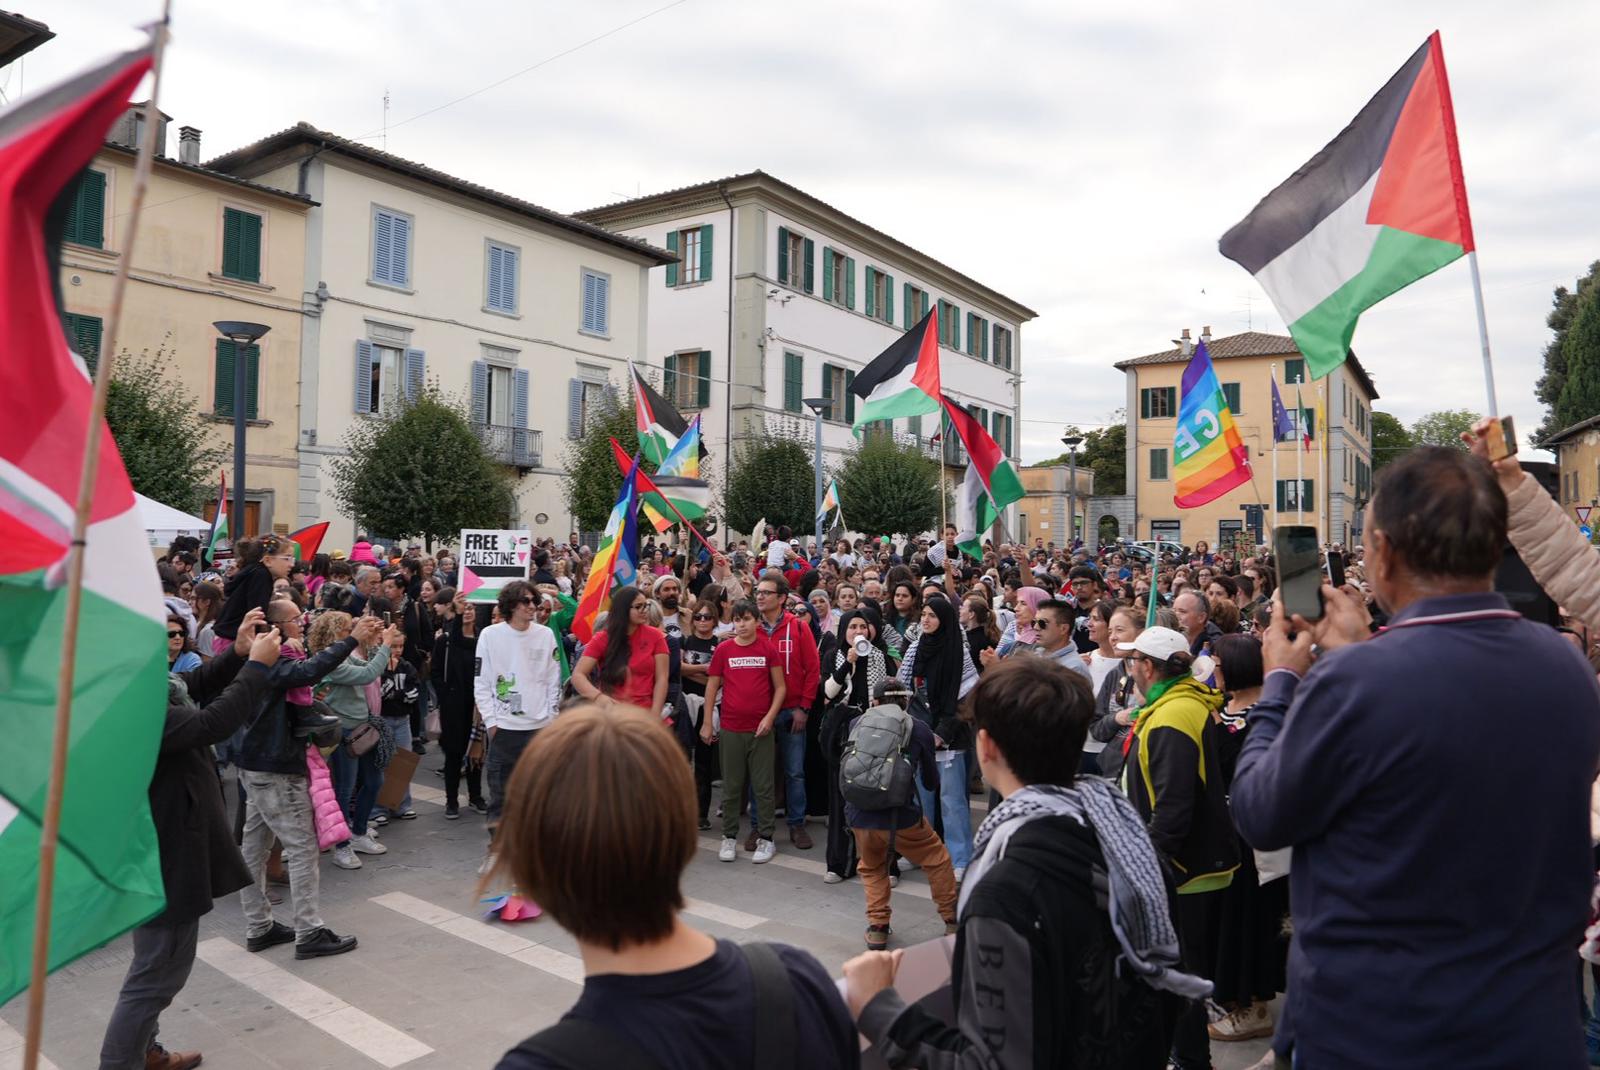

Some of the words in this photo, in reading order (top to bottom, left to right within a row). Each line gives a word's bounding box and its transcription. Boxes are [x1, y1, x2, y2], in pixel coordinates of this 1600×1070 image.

[465, 534, 498, 550] FREE
[464, 551, 516, 565] PALESTINE
[730, 658, 764, 666] NOTHING
